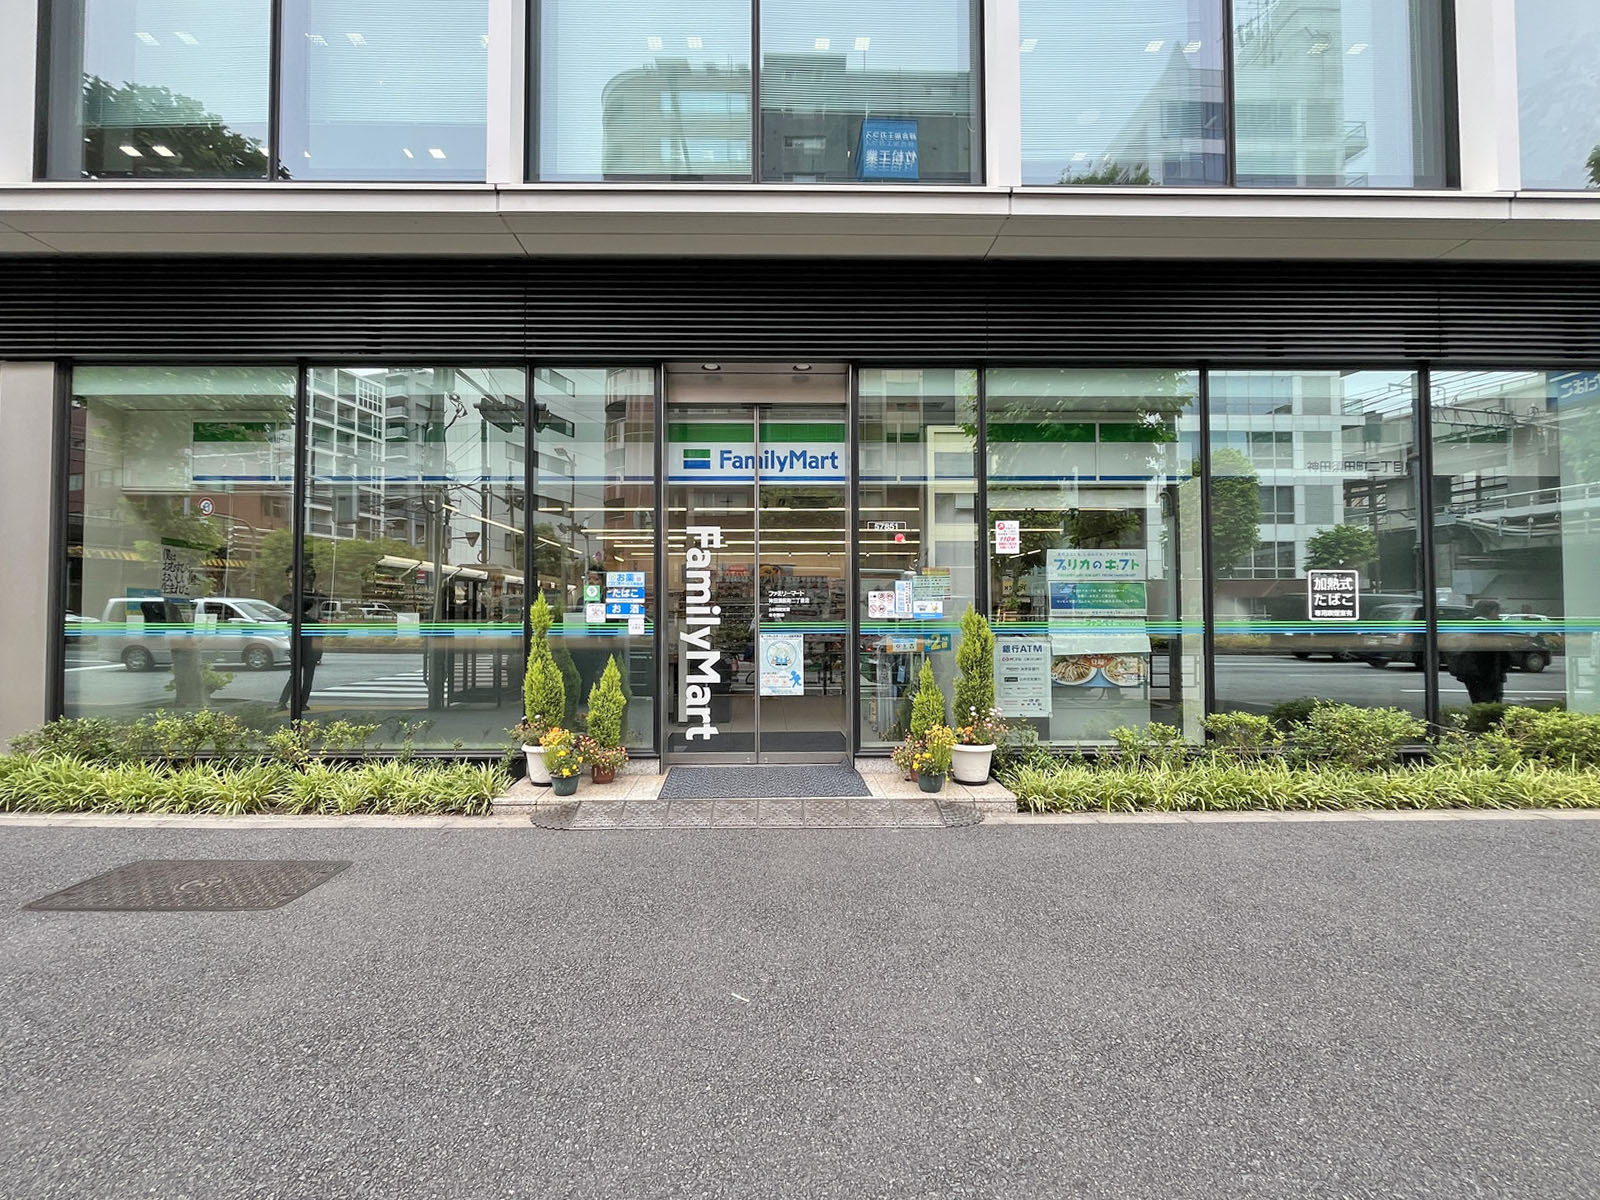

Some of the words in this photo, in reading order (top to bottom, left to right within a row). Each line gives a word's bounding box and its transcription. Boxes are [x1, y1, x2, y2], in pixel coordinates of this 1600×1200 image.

[720, 449, 839, 472] FamilyMart
[1313, 577, 1354, 591] 加熱式
[1313, 593, 1354, 606] たばこ
[679, 525, 722, 741] FamilyMart
[1002, 644, 1043, 654] 銀行ATM
